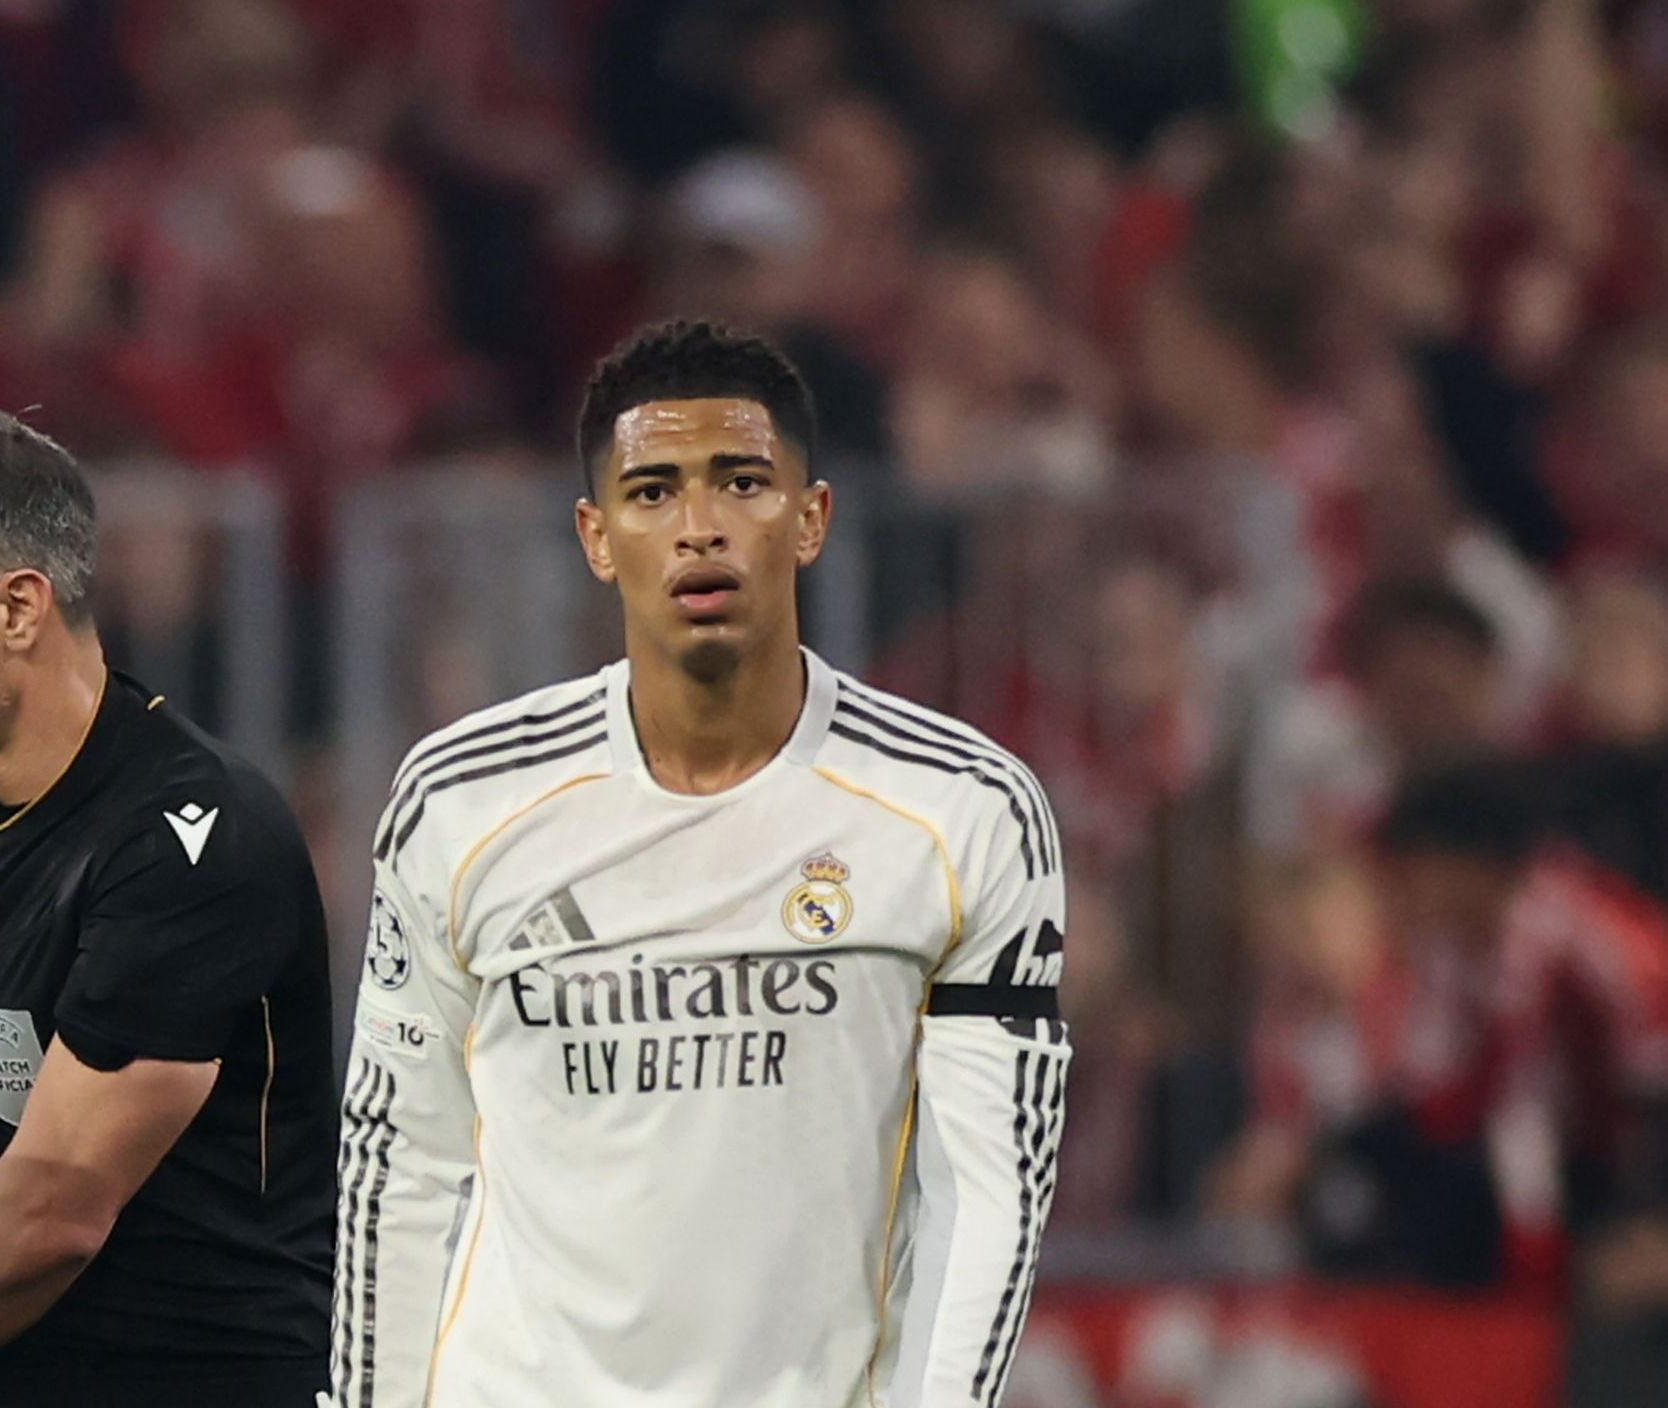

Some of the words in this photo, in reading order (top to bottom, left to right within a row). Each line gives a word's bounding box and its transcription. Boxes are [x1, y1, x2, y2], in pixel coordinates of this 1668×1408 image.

[510, 953, 838, 1028] Emirates
[563, 1040, 618, 1095] FLY
[637, 1030, 787, 1094] BETTER
